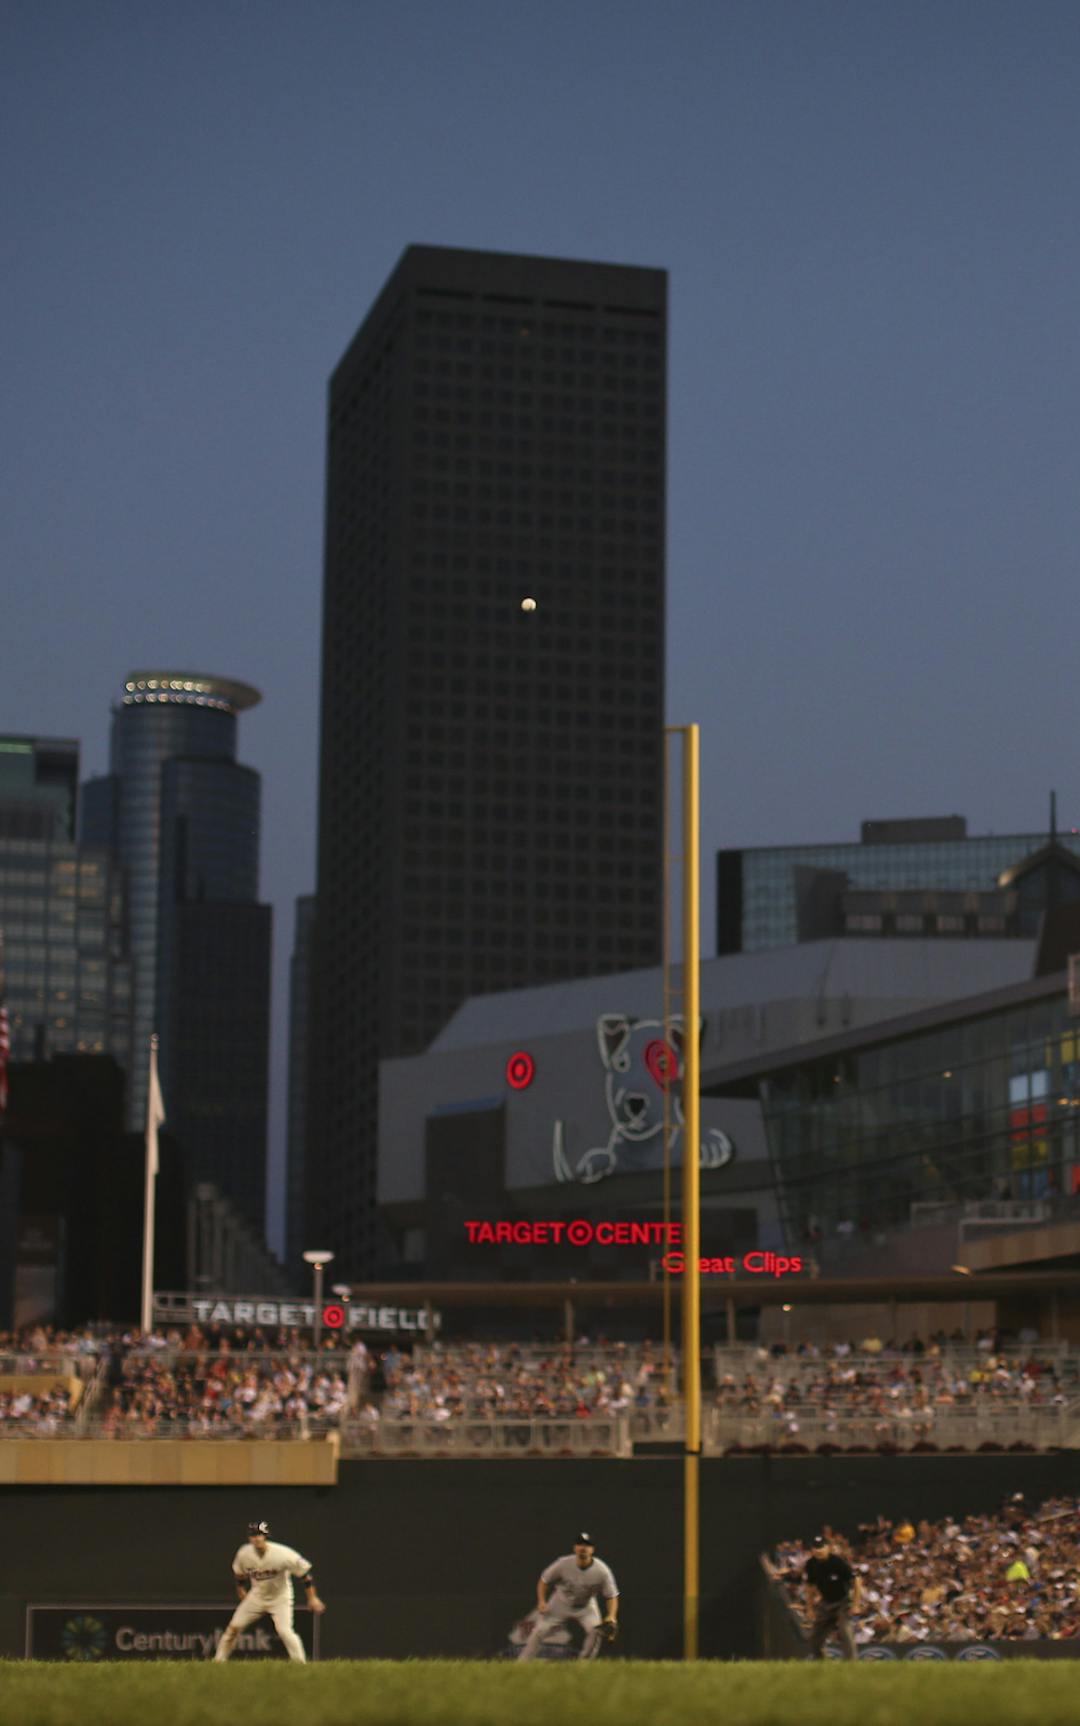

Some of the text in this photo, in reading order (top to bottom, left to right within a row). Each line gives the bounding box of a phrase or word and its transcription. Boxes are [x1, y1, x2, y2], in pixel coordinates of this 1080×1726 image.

[464, 1221, 688, 1245] TARGET CENTE
[661, 1251, 803, 1277] Geat Clips
[192, 1301, 317, 1326] TARGET
